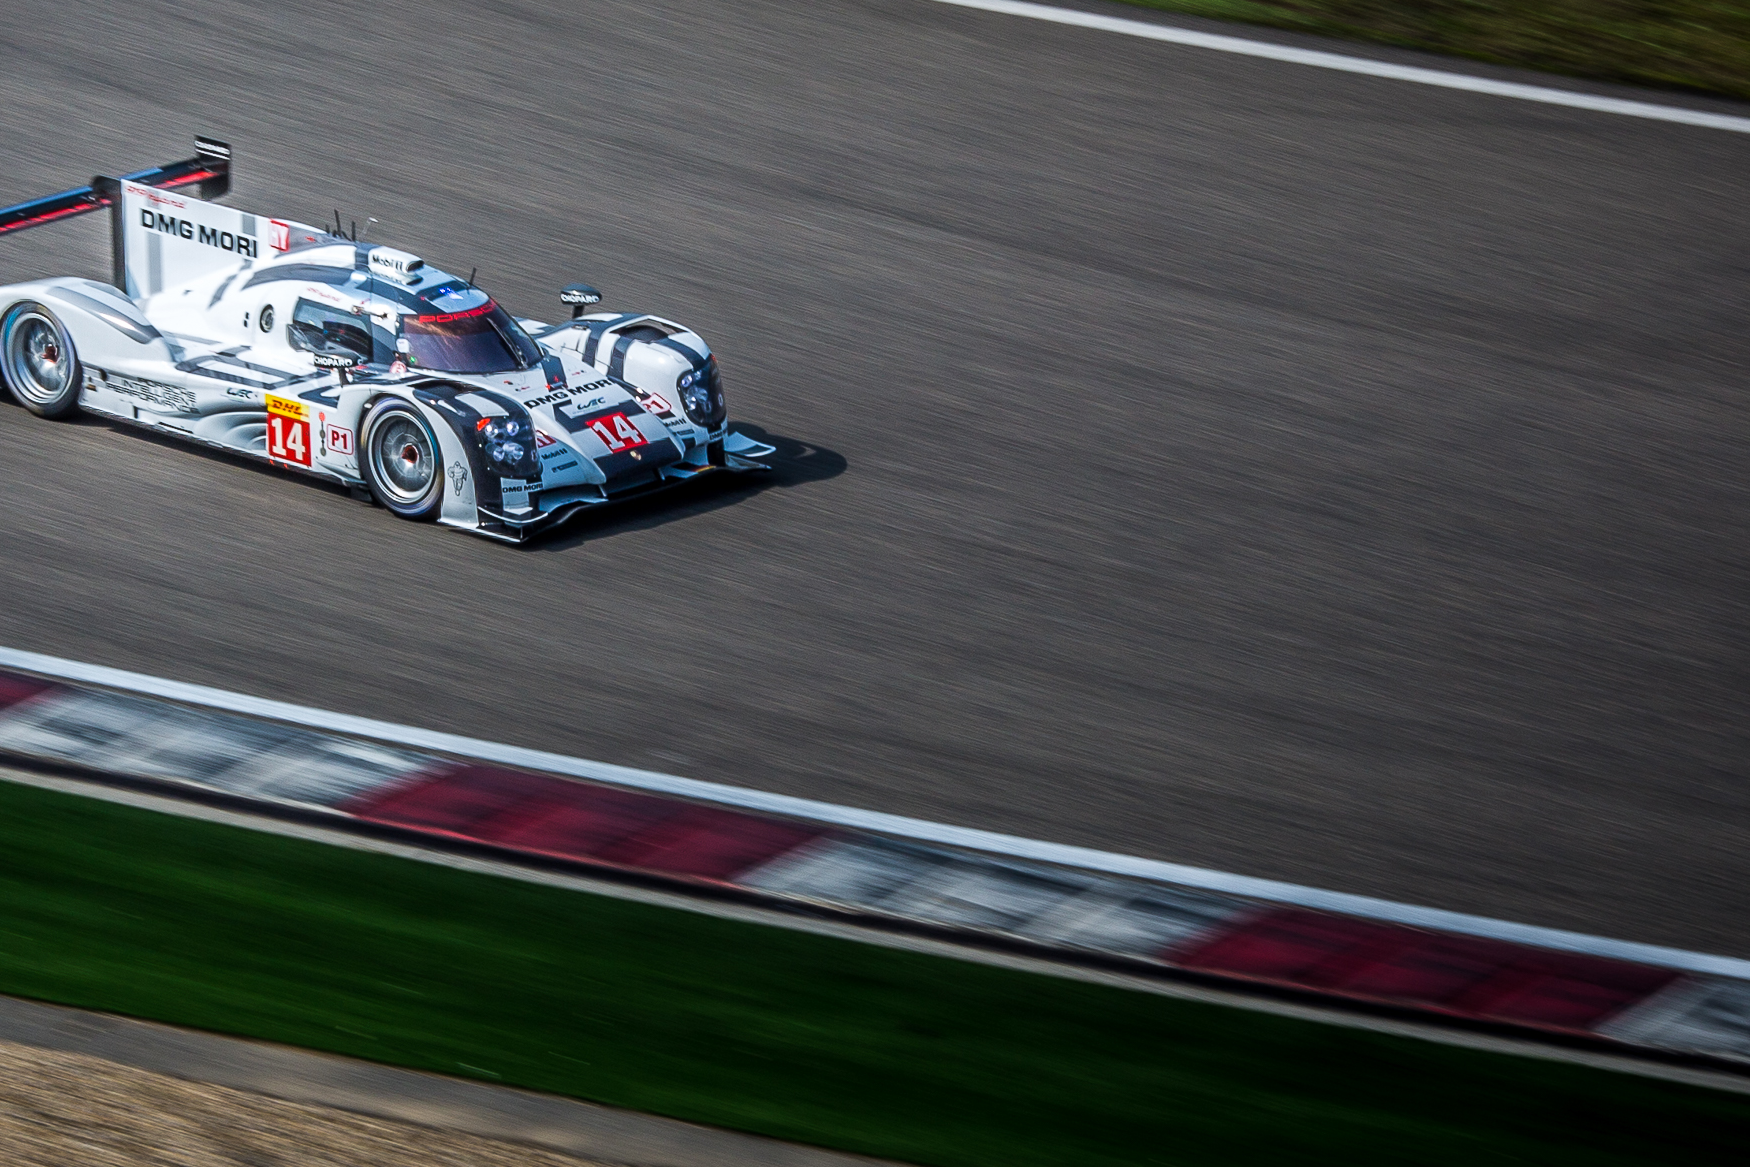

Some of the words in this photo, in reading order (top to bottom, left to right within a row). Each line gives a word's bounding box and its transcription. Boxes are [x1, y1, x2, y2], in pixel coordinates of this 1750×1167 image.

[140, 208, 194, 240] DMG
[198, 224, 258, 259] MORI
[271, 399, 302, 415] DHL
[523, 391, 569, 410] DMG
[577, 397, 606, 410] WEC
[271, 417, 306, 461] 14
[331, 430, 348, 450] P1
[592, 415, 642, 450] 14
